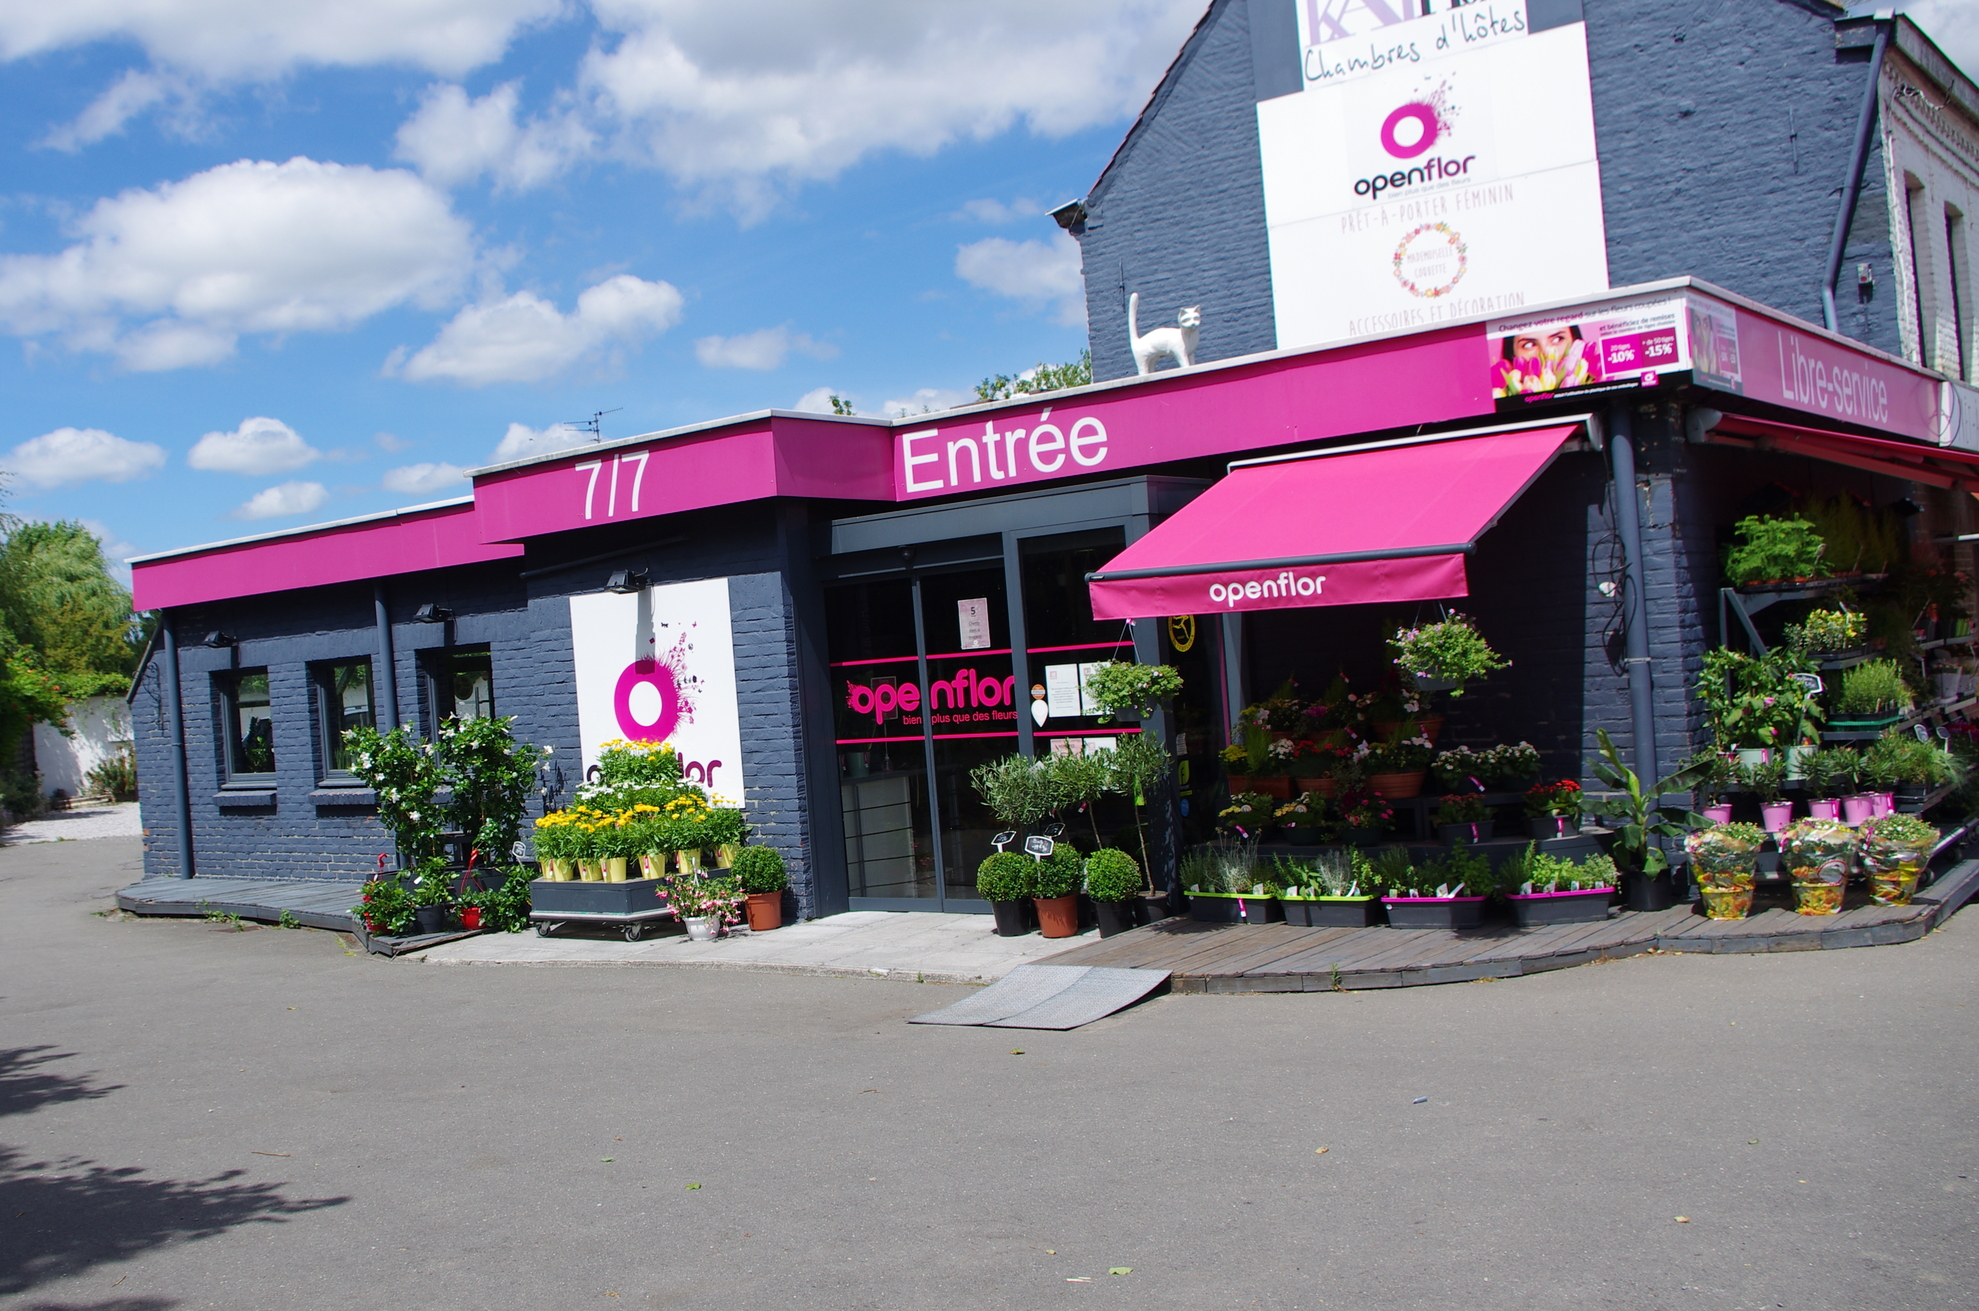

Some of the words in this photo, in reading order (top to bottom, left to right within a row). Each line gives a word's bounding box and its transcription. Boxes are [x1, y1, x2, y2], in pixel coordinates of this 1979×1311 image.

[1305, 42, 1421, 81] Chambres
[1436, 6, 1525, 50] d'hôtes
[1354, 155, 1476, 200] openflor
[1456, 183, 1514, 212] FÉMININ
[1349, 308, 1425, 336] ACCESSOIRES
[1430, 305, 1443, 322] ET
[1450, 292, 1525, 319] DÉCORATION
[1499, 321, 1533, 332] Changez
[1534, 315, 1556, 326] votre
[1557, 312, 1584, 324] regard
[1778, 331, 1888, 423] Libre-service
[902, 408, 1108, 493] Entrée
[574, 450, 649, 519] 7/7
[1209, 572, 1326, 607] openflor
[903, 715, 922, 725] bien
[931, 712, 950, 726] plus
[953, 713, 970, 724] que
[973, 711, 990, 722] des
[991, 709, 1018, 721] fleurs
